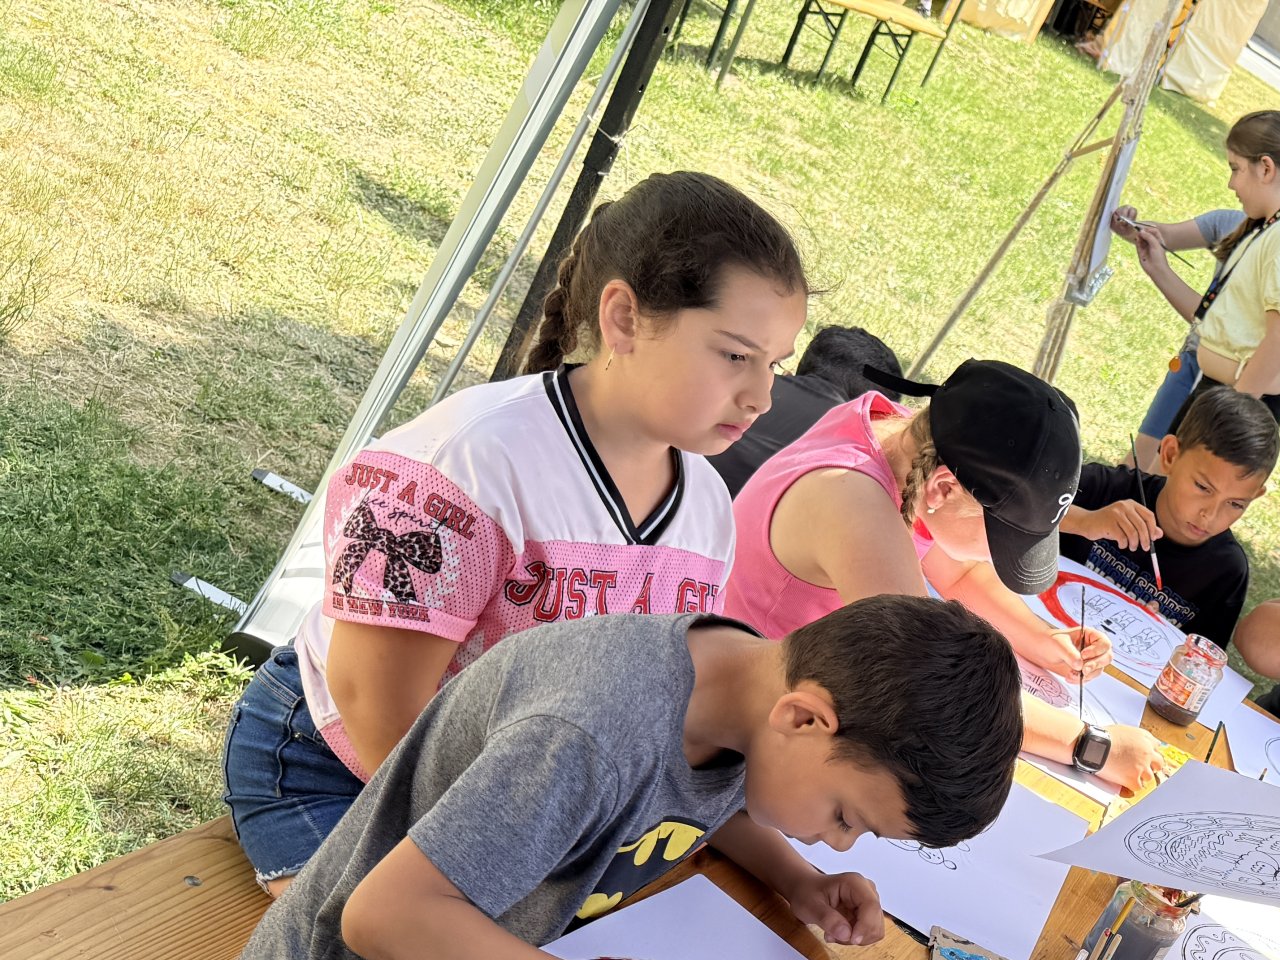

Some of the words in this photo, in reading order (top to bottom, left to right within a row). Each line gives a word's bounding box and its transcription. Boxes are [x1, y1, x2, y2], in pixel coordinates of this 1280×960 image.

[345, 463, 399, 495] JUST
[397, 480, 417, 506] A
[423, 493, 477, 541] GIRL
[332, 592, 346, 611] IN
[348, 597, 385, 618] NEW
[388, 601, 431, 623] YORK
[504, 561, 618, 622] JUST
[629, 573, 654, 615] A
